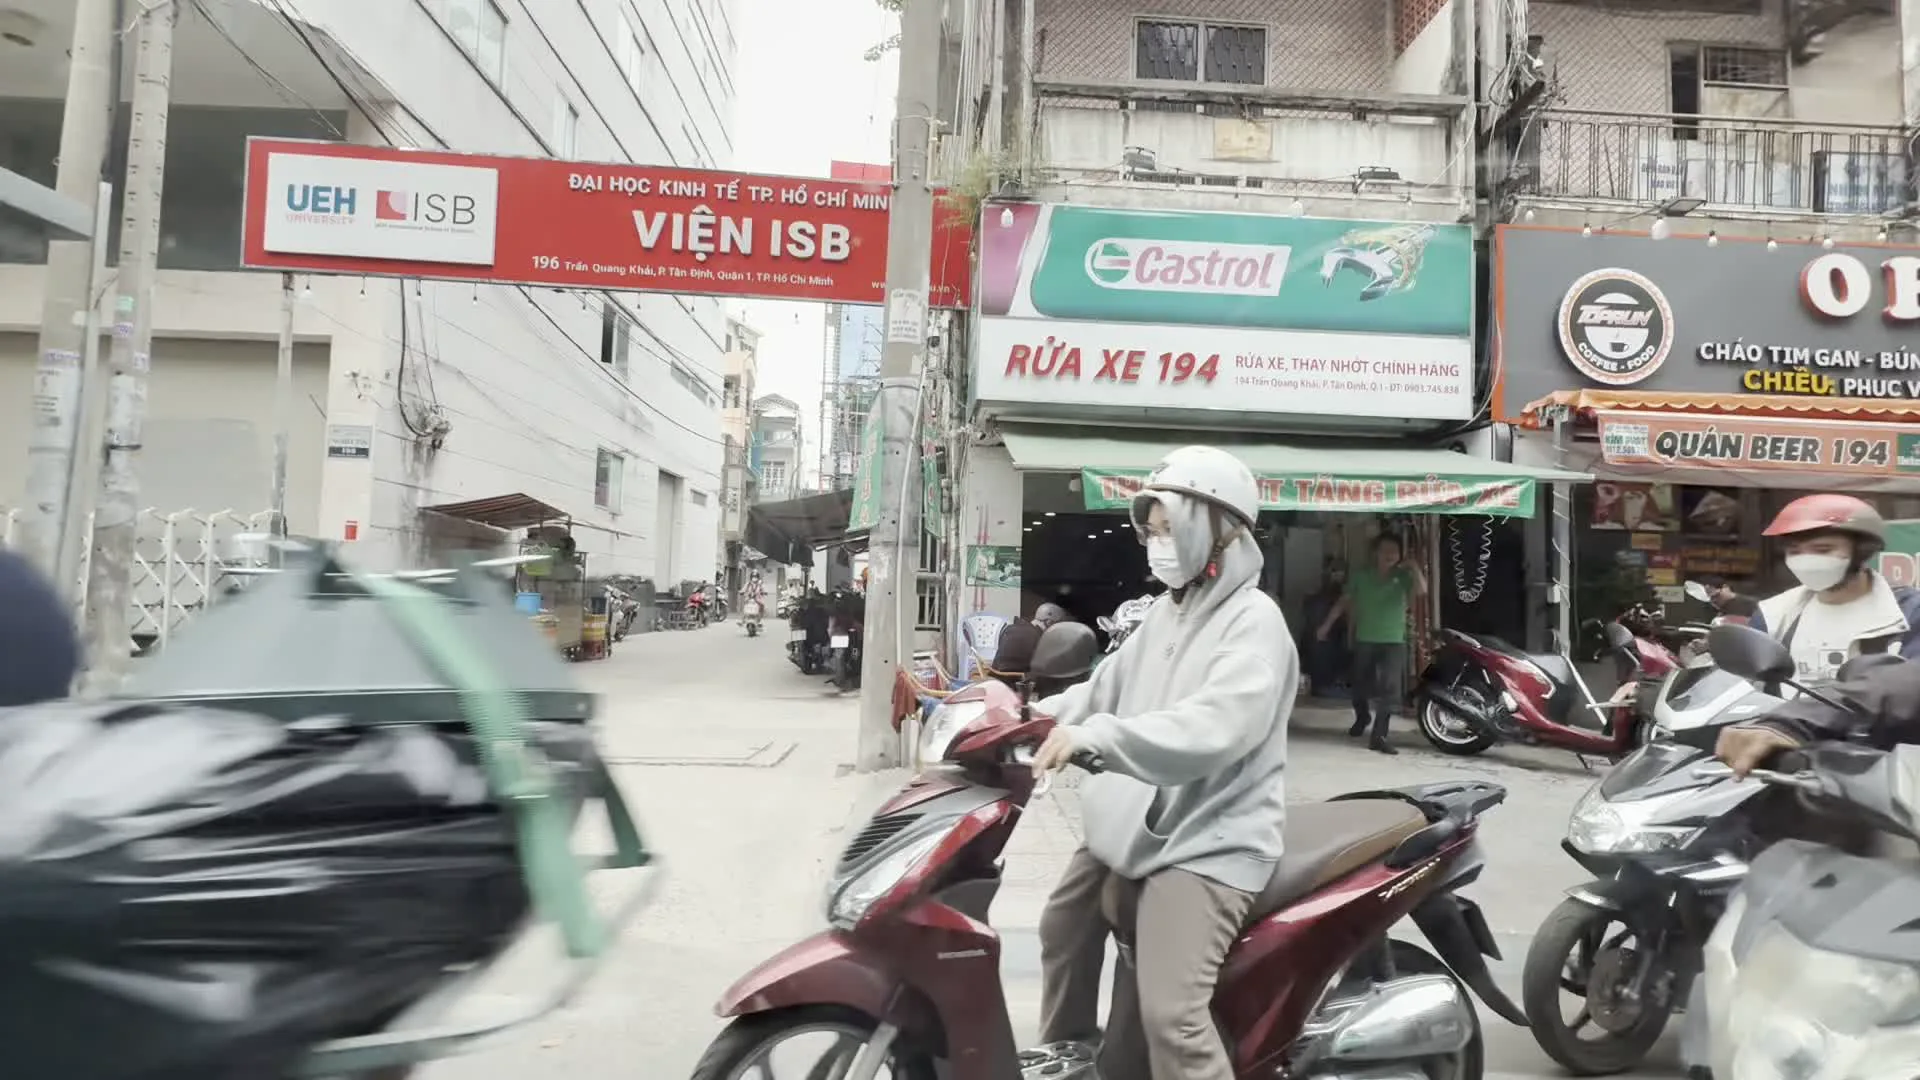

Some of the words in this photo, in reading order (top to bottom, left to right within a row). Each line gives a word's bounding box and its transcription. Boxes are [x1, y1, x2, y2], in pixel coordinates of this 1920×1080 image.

[286, 183, 357, 216] UEH
[413, 191, 476, 225] ISB
[567, 173, 603, 193] ĐẠI
[609, 176, 651, 196] HỌC
[658, 179, 706, 198] KINH
[714, 178, 741, 200] TẾ
[814, 189, 849, 208] CHÍ
[852, 193, 892, 211] MIN
[632, 204, 752, 262] VIỆN
[770, 219, 851, 262] ISB
[532, 255, 560, 270] 196
[592, 263, 627, 276] Quang
[809, 275, 834, 287] Minh
[1134, 246, 1276, 289] Castrol
[1004, 335, 1081, 378] RỬA
[1093, 349, 1147, 383] XE
[1158, 351, 1220, 383] 194
[1291, 358, 1327, 371] THAY
[1372, 359, 1416, 375] CHÍNH
[1578, 342, 1619, 372] COFFEE
[1626, 344, 1656, 370] FOOD
[1699, 337, 1763, 362] CHÁO
[1768, 346, 1811, 365] TIM
[1815, 349, 1861, 368] GAN
[1655, 424, 1745, 462] QUÁN
[1748, 433, 1823, 465] BEER
[1831, 438, 1891, 467] 194
